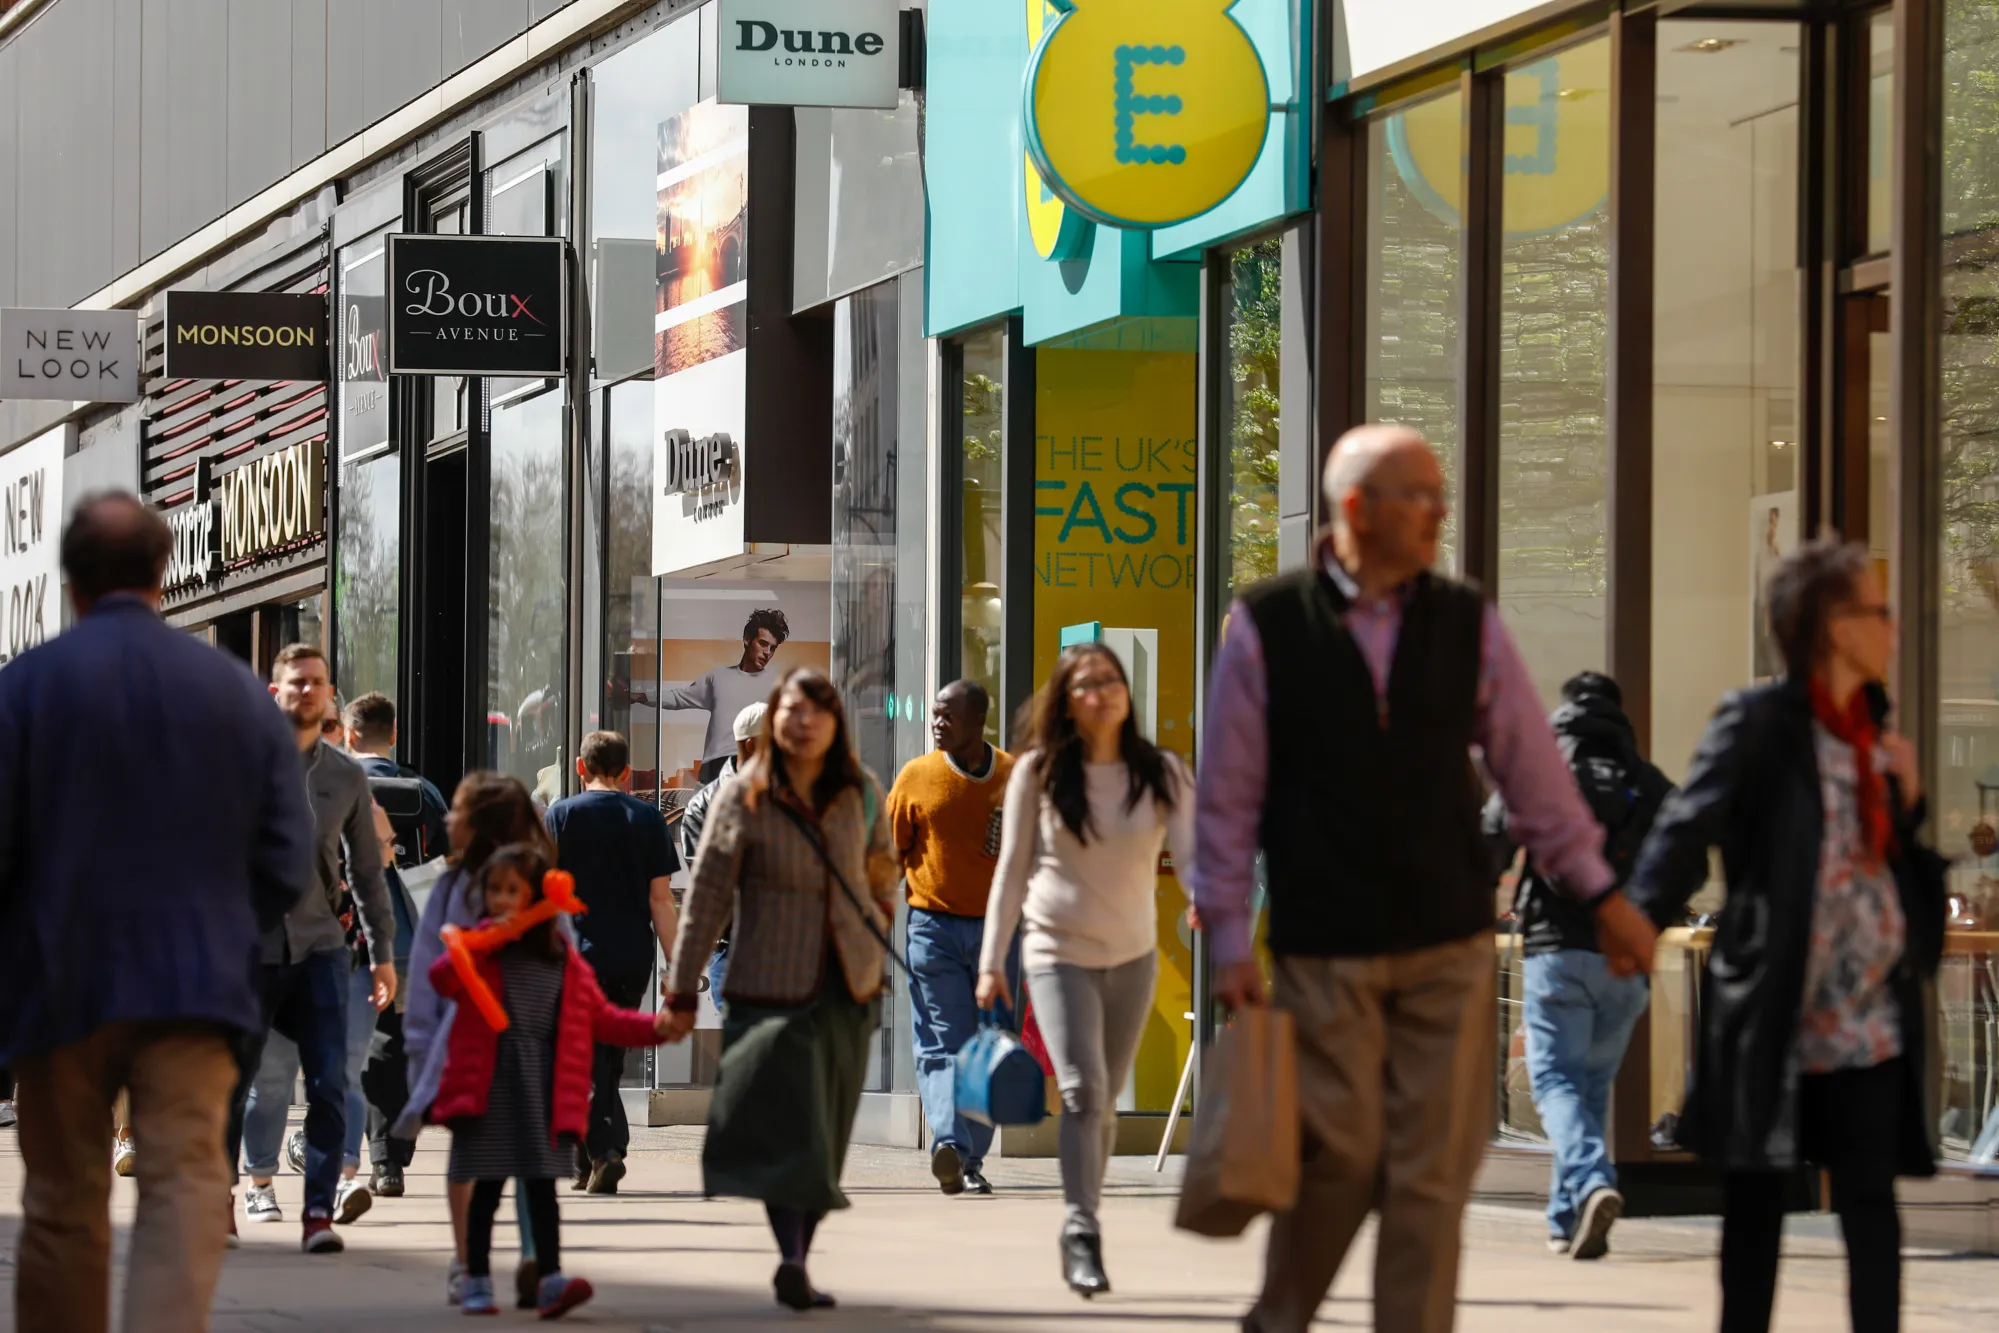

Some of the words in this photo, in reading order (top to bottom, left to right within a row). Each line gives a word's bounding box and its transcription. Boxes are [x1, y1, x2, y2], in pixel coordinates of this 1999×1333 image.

[735, 19, 884, 56] Dune
[773, 57, 846, 68] LONDON
[1114, 44, 1186, 165] E
[405, 269, 549, 327] Boux
[26, 329, 111, 351] NEW
[176, 324, 315, 347] MONSOON
[347, 304, 384, 381] Boux
[435, 327, 519, 341] AVENUE
[18, 357, 119, 379] LOOK
[664, 428, 732, 496] Dune
[1036, 435, 1103, 471] HE
[4, 467, 46, 559] NEW
[221, 439, 312, 562] MONSOON
[0, 572, 47, 664] LOOK
